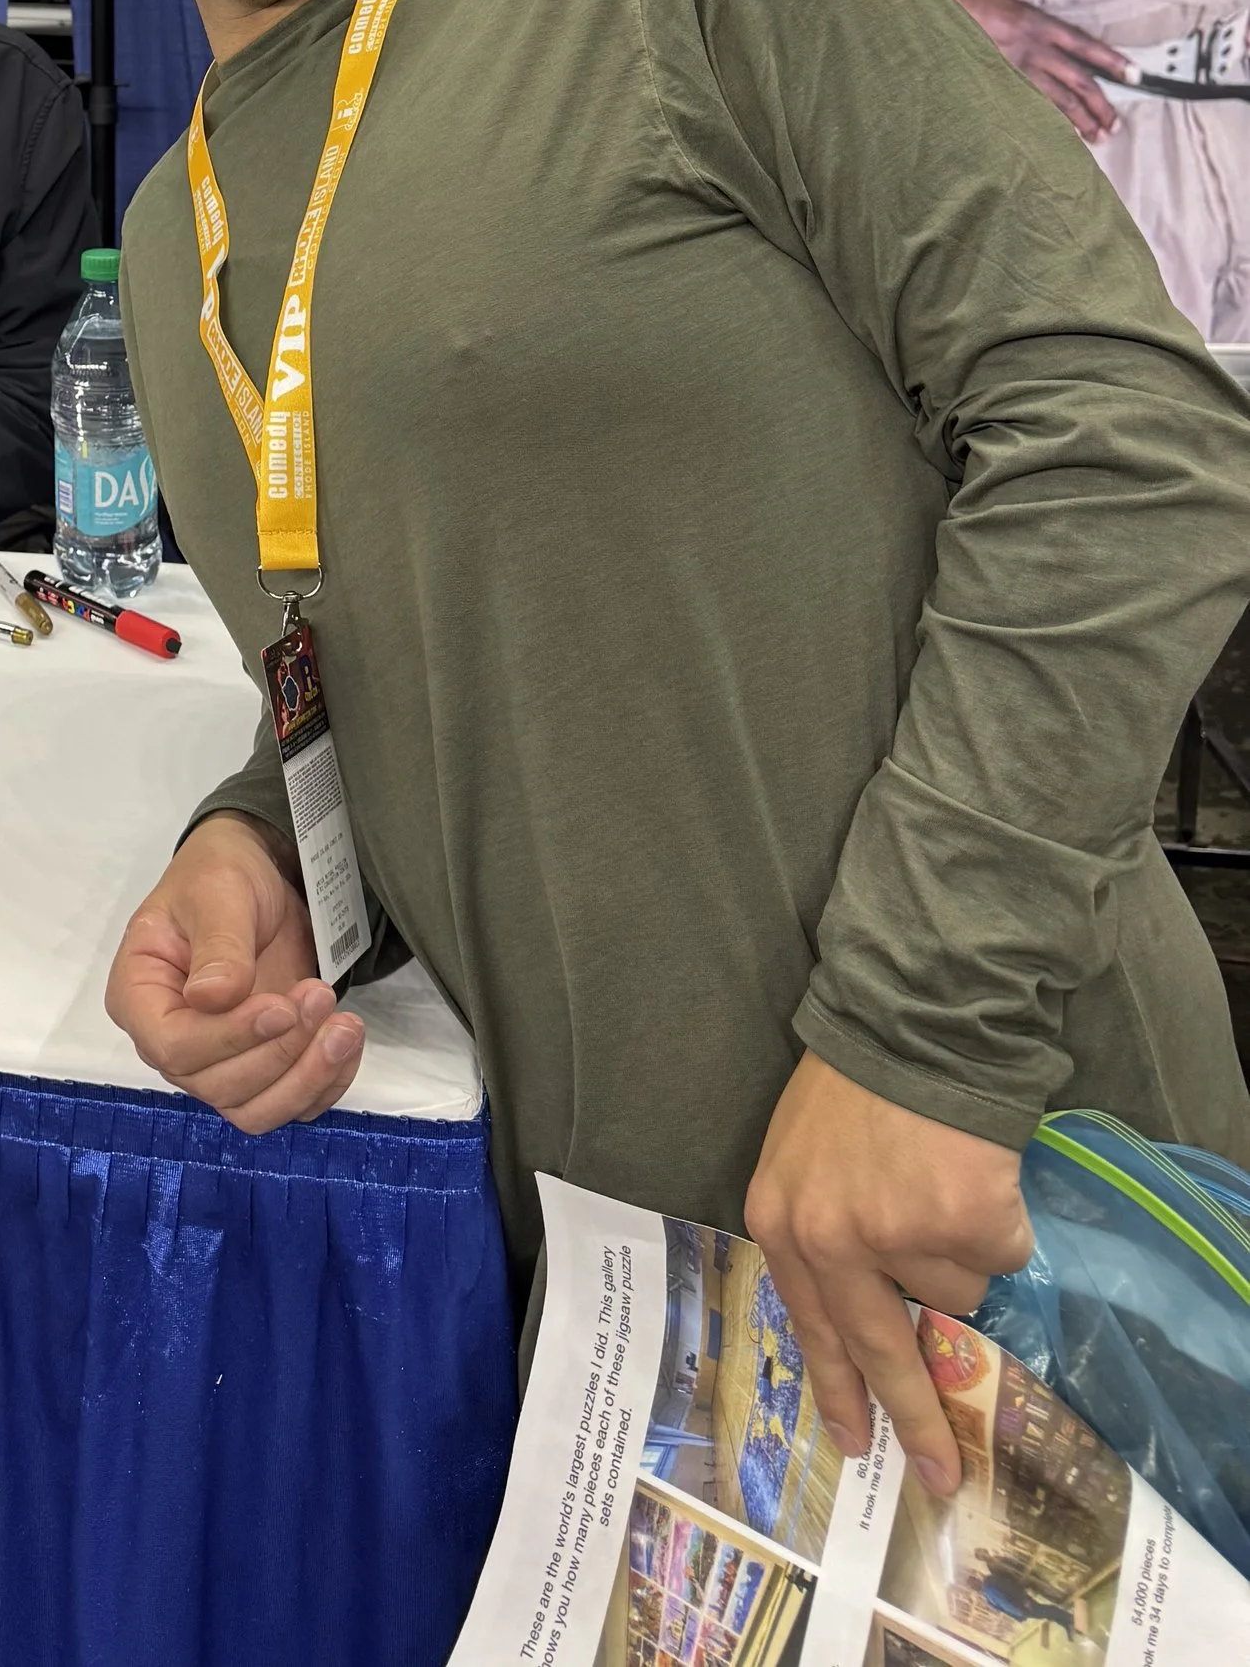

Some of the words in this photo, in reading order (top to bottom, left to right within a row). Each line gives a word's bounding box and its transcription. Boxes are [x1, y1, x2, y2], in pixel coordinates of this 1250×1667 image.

[312, 145, 341, 207] ISLAND
[201, 175, 224, 246] comedy
[271, 294, 307, 402] VIP
[302, 411, 312, 453] ISLAND
[266, 411, 290, 499] comedy
[304, 459, 313, 499] RHODE
[602, 1246, 617, 1293] gallery
[619, 1245, 634, 1291] puzzle
[599, 1295, 613, 1325] This
[616, 1292, 631, 1344] jigsaw
[594, 1332, 609, 1359] did.
[607, 1343, 626, 1387] these
[580, 1372, 600, 1433] puzzles
[604, 1387, 617, 1407] of
[596, 1411, 612, 1449] each
[881, 1412, 890, 1424] to
[877, 1427, 891, 1453] days
[566, 1434, 587, 1489] largest
[584, 1452, 602, 1507] pieces
[600, 1491, 614, 1527] sets
[607, 1408, 632, 1490] contained.
[874, 1454, 885, 1470] 60
[871, 1471, 881, 1492] me
[555, 1491, 575, 1548] world's
[860, 1519, 870, 1531] It
[862, 1493, 877, 1520] took
[574, 1507, 594, 1554] many
[546, 1551, 562, 1579] the
[563, 1557, 581, 1593] how
[1131, 1581, 1148, 1627] 54,000
[1140, 1538, 1156, 1581] pieces
[1158, 1557, 1170, 1571] to
[539, 1580, 554, 1609] are
[1153, 1574, 1169, 1604] days
[554, 1594, 571, 1629] you
[1149, 1606, 1161, 1624] 34
[520, 1611, 545, 1659] These
[1148, 1625, 1159, 1647] me
